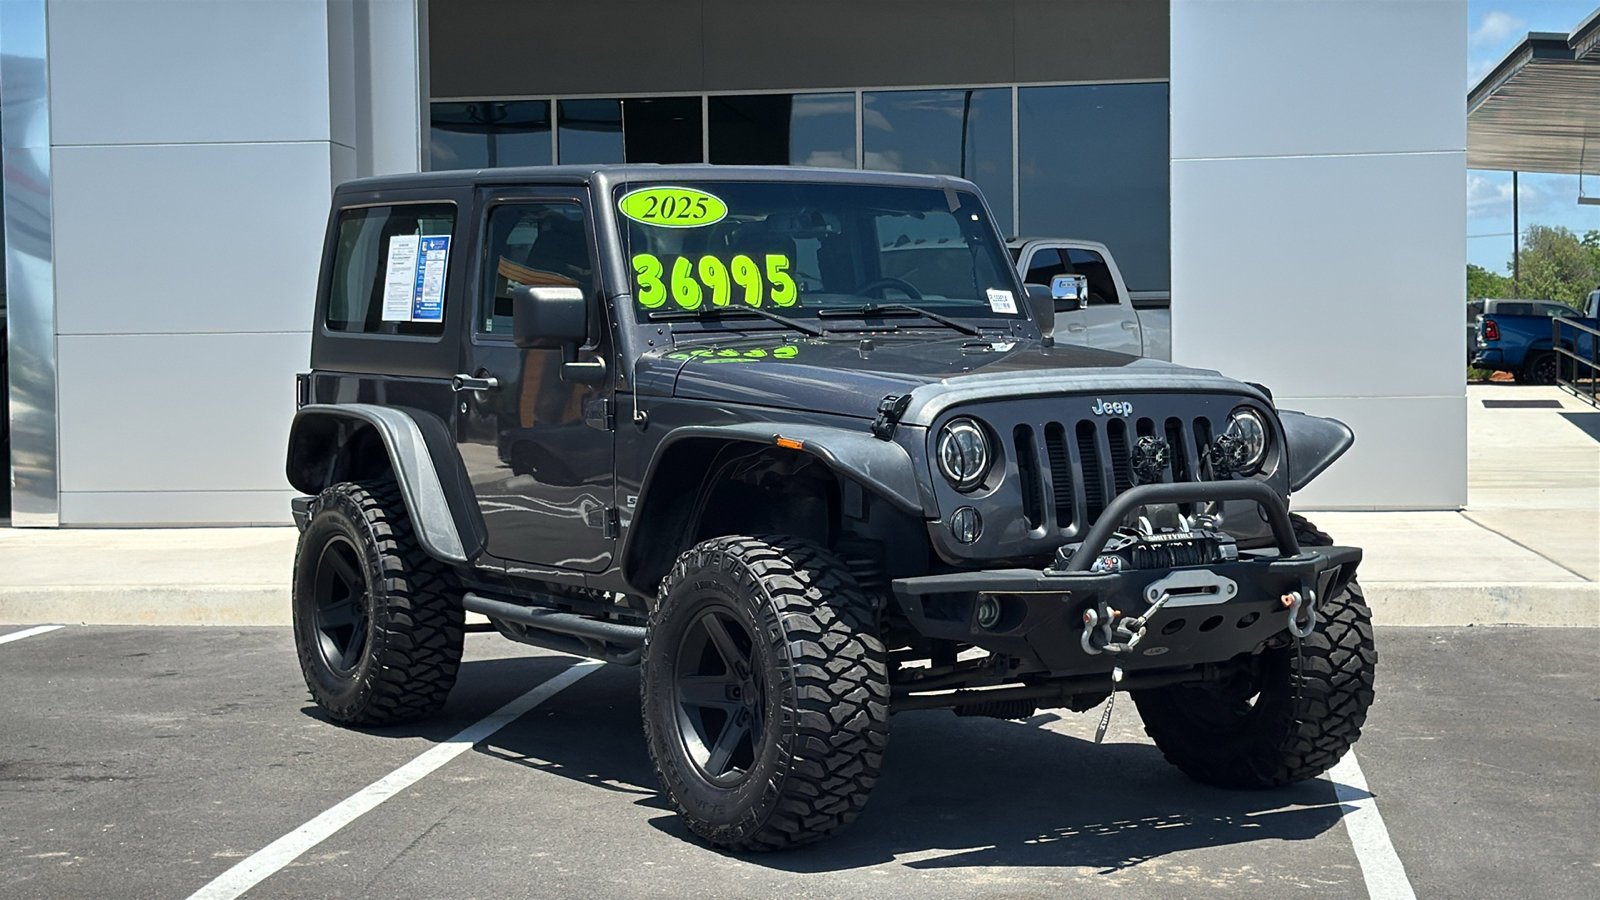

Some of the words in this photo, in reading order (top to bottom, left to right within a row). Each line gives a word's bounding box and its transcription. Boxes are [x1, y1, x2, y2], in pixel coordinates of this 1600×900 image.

[642, 195, 709, 219] 2025
[631, 253, 798, 311] 36995
[1091, 397, 1133, 417] Jeep
